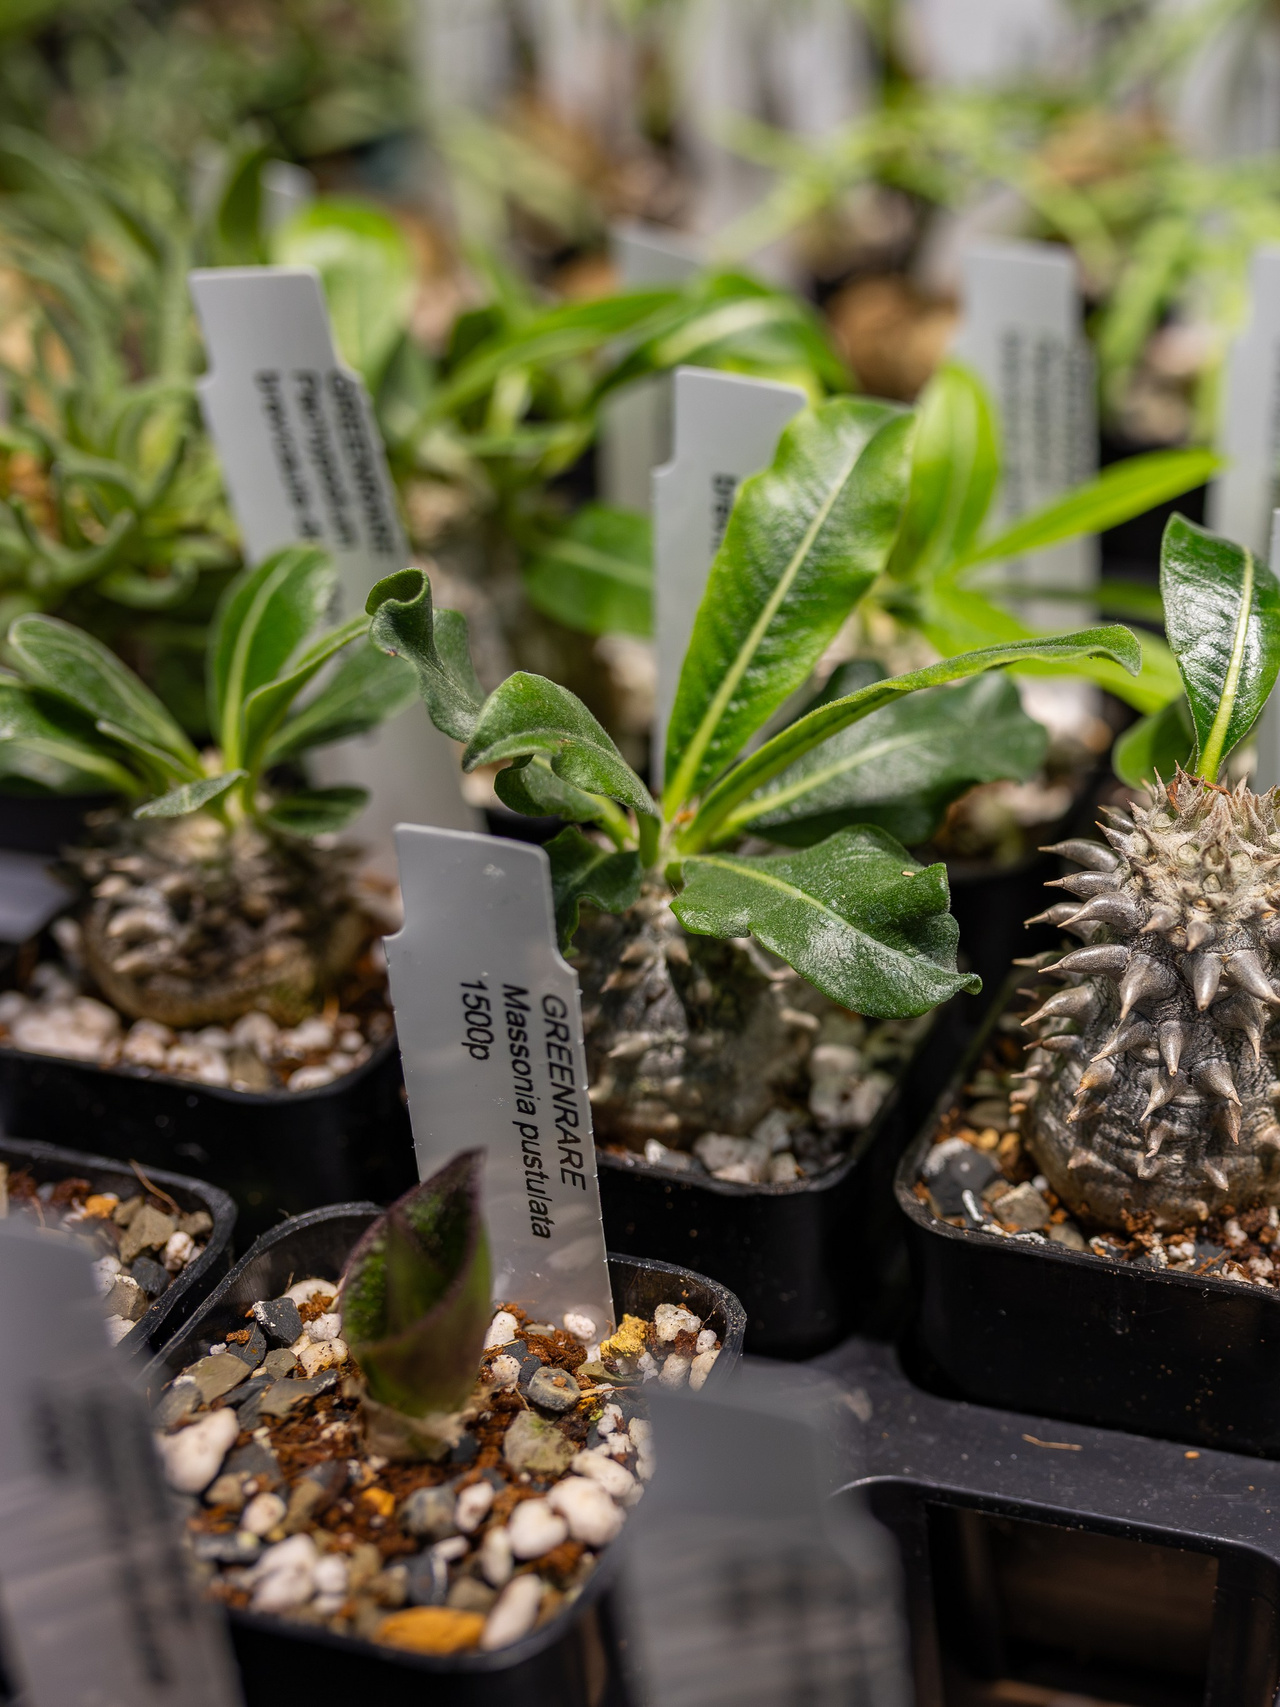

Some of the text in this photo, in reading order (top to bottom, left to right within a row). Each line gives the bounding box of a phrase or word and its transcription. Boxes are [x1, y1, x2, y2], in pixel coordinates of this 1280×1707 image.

[460, 979, 495, 1061] 1500p
[502, 983, 555, 1239] Massonia pustulata
[541, 994, 587, 1190] GREENRARE
